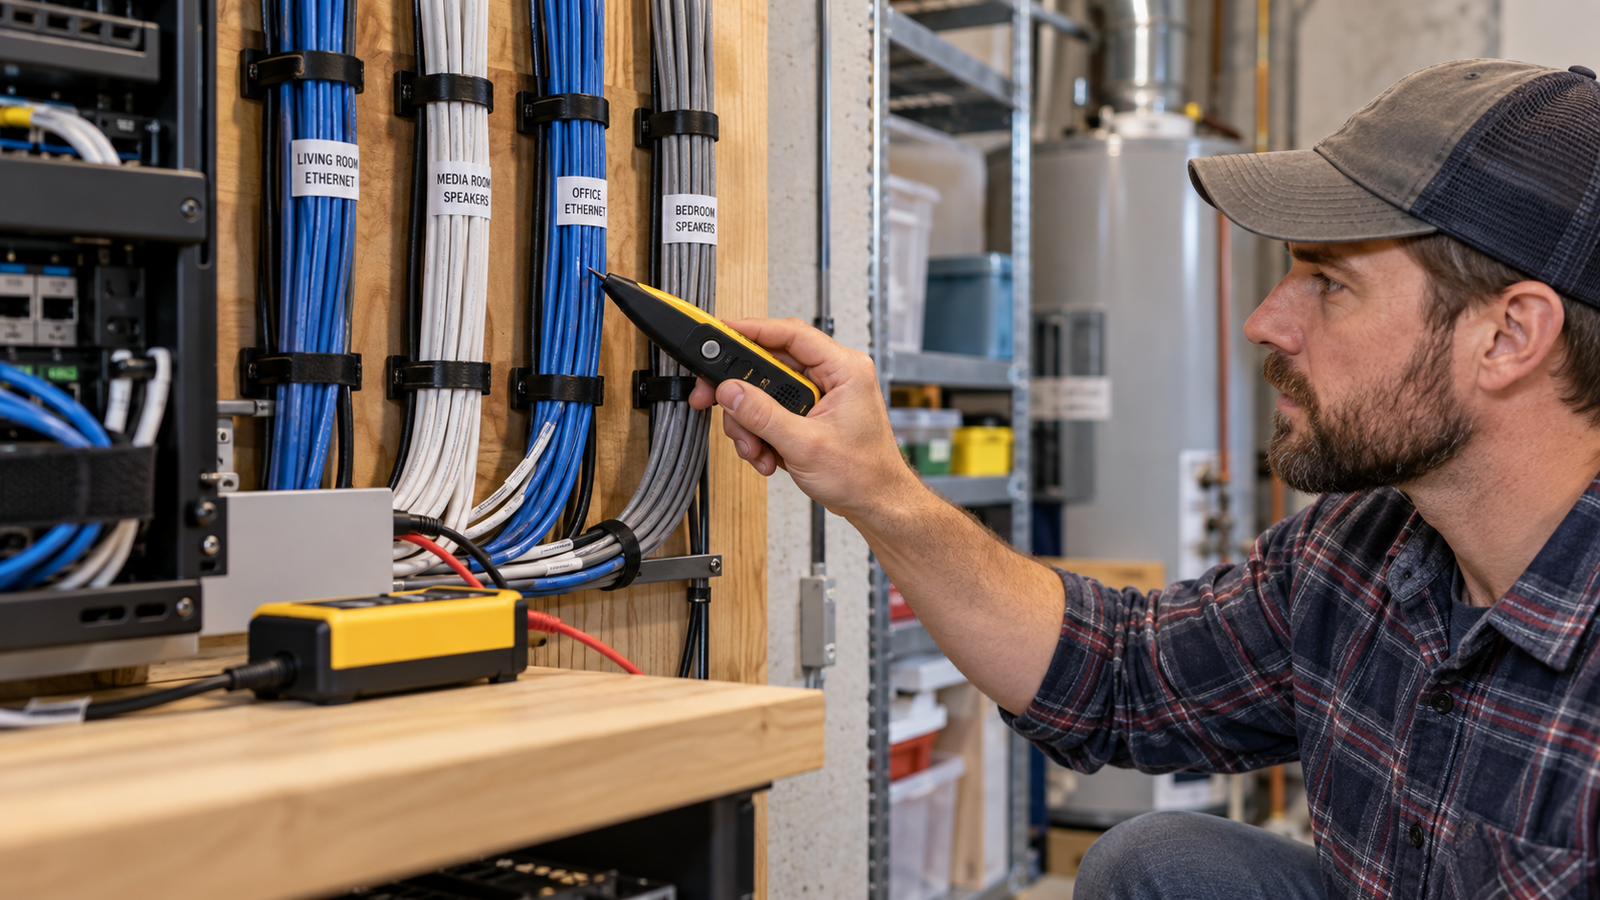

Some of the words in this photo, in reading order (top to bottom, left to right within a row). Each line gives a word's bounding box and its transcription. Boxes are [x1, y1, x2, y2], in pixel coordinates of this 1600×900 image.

[297, 153, 332, 165] LIVING
[336, 154, 358, 170] ROOM
[305, 172, 355, 187] ETHERNET
[437, 173, 468, 185] MEDIA
[471, 175, 490, 189] ROOM
[444, 191, 489, 206] SPEAKERS
[572, 187, 601, 200] OFFICE
[565, 203, 606, 217] ETHERNET
[676, 205, 715, 218] BEDROOM
[676, 221, 715, 234] SPEAKERS
